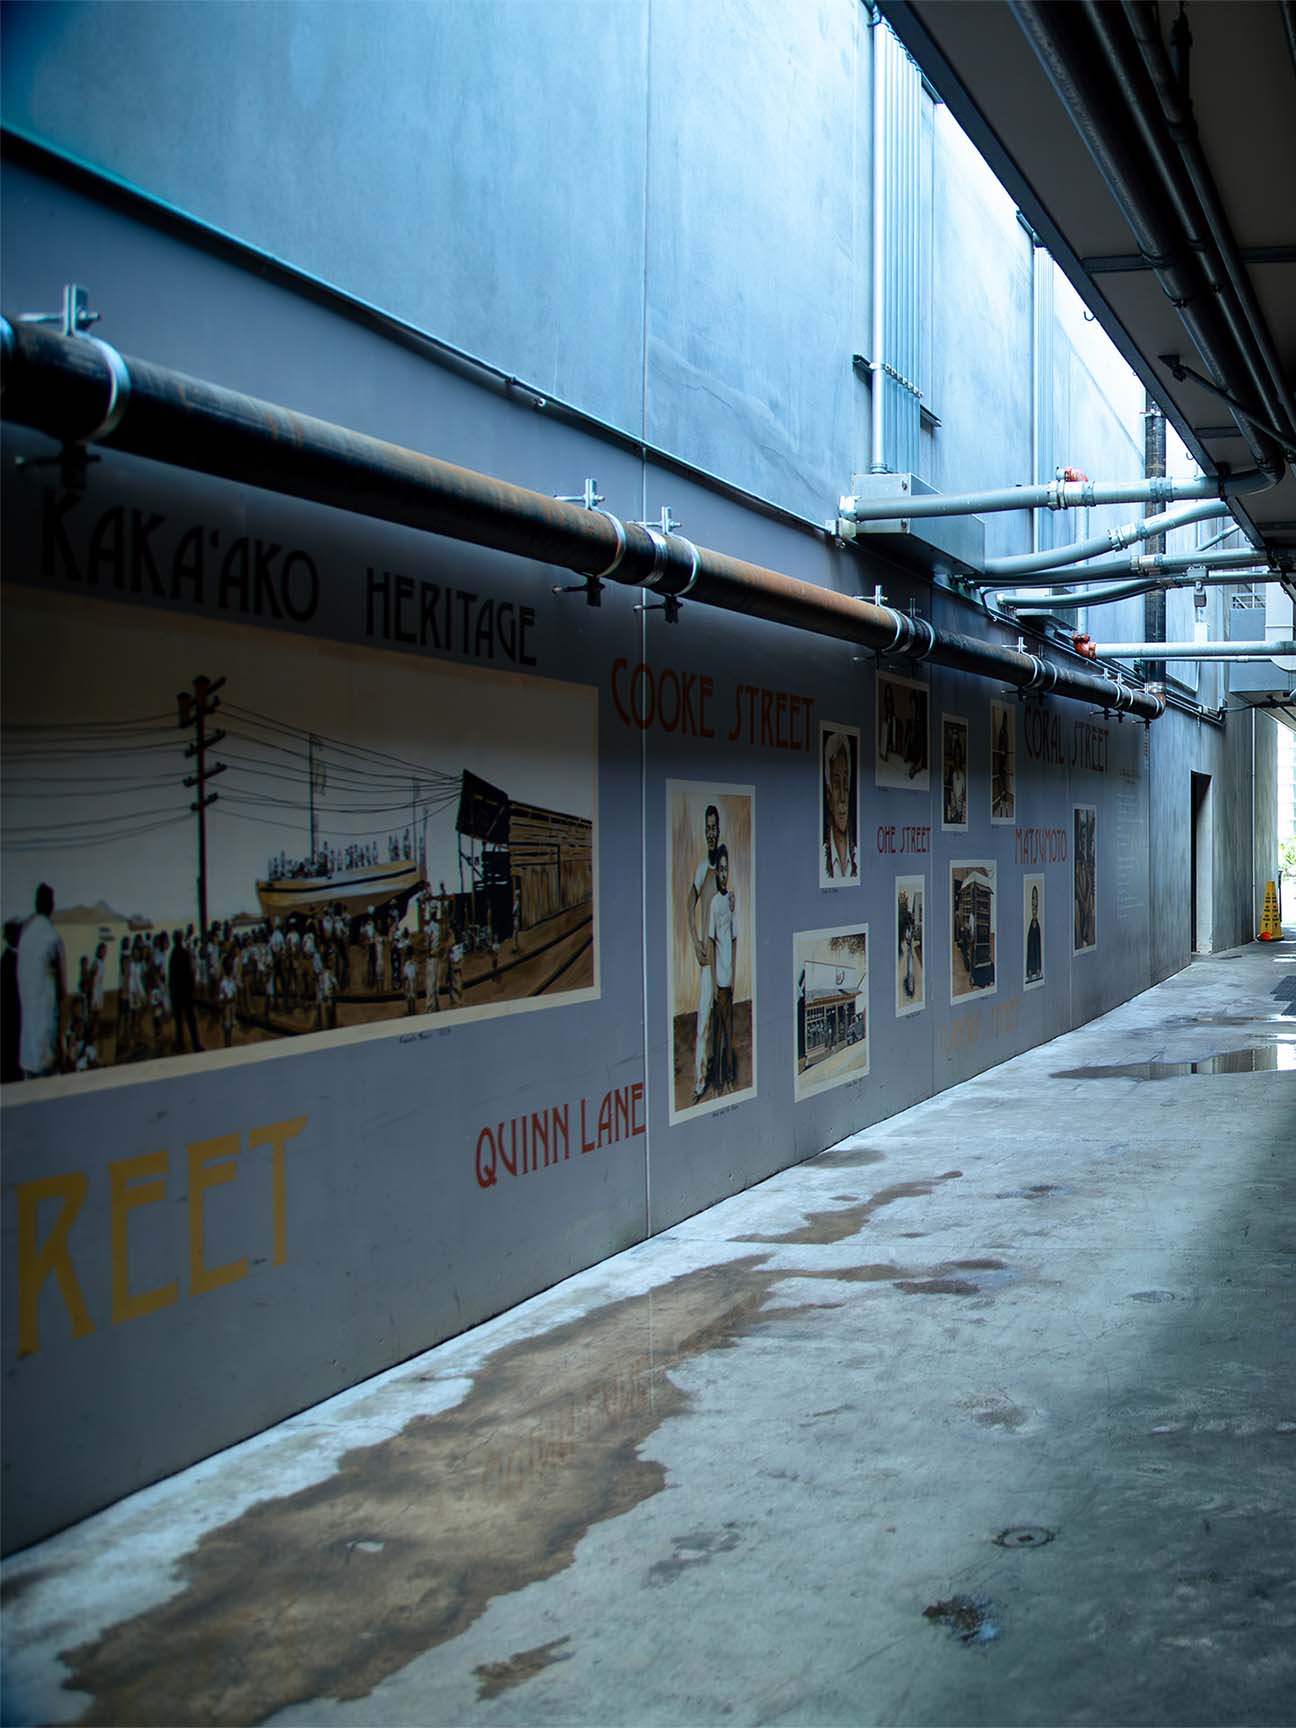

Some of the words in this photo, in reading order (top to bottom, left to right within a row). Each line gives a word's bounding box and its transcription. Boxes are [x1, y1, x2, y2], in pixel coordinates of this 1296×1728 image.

[366, 566, 538, 667] HERITAGE
[611, 657, 715, 738] COOKE
[727, 683, 815, 752] STREET
[1023, 706, 1065, 765] CORAL
[1071, 719, 1111, 772] STREET
[900, 826, 931, 853] STREET
[1015, 826, 1068, 865] MATSUMOTO
[475, 1103, 572, 1189] QUINN
[581, 1082, 647, 1154] LANE
